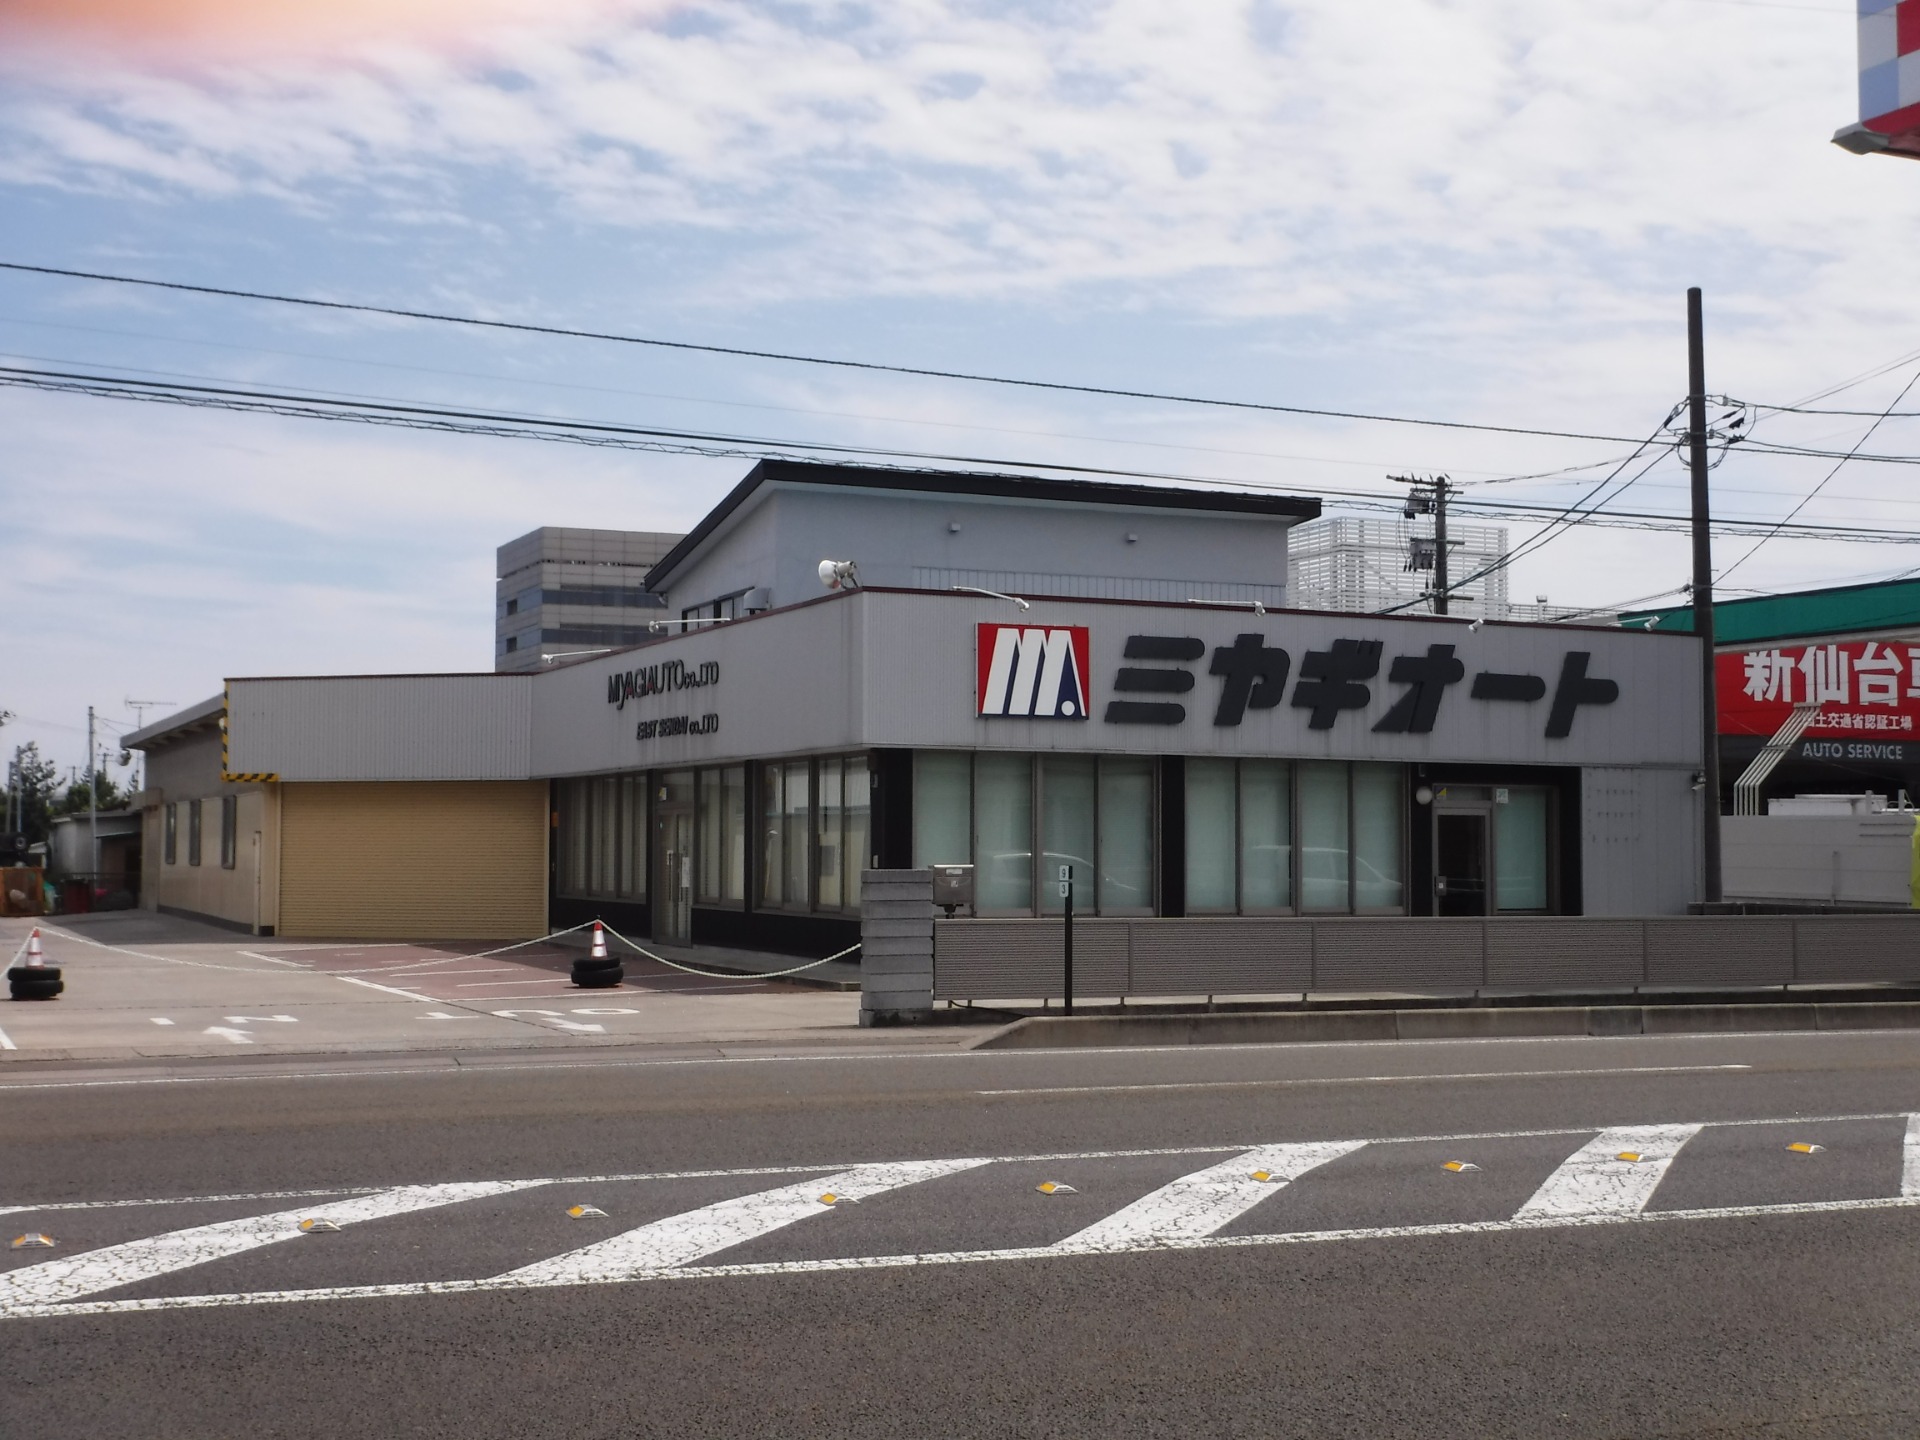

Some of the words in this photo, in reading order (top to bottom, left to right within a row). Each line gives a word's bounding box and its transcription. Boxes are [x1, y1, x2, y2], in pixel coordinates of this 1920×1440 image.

[1104, 633, 1620, 739] ミヤギオート
[1743, 642, 1920, 707] 新仙台
[636, 719, 658, 740] EAST
[658, 715, 688, 738] SENDAI
[1802, 742, 1843, 757] AUTO
[1848, 743, 1903, 760] SERVICE
